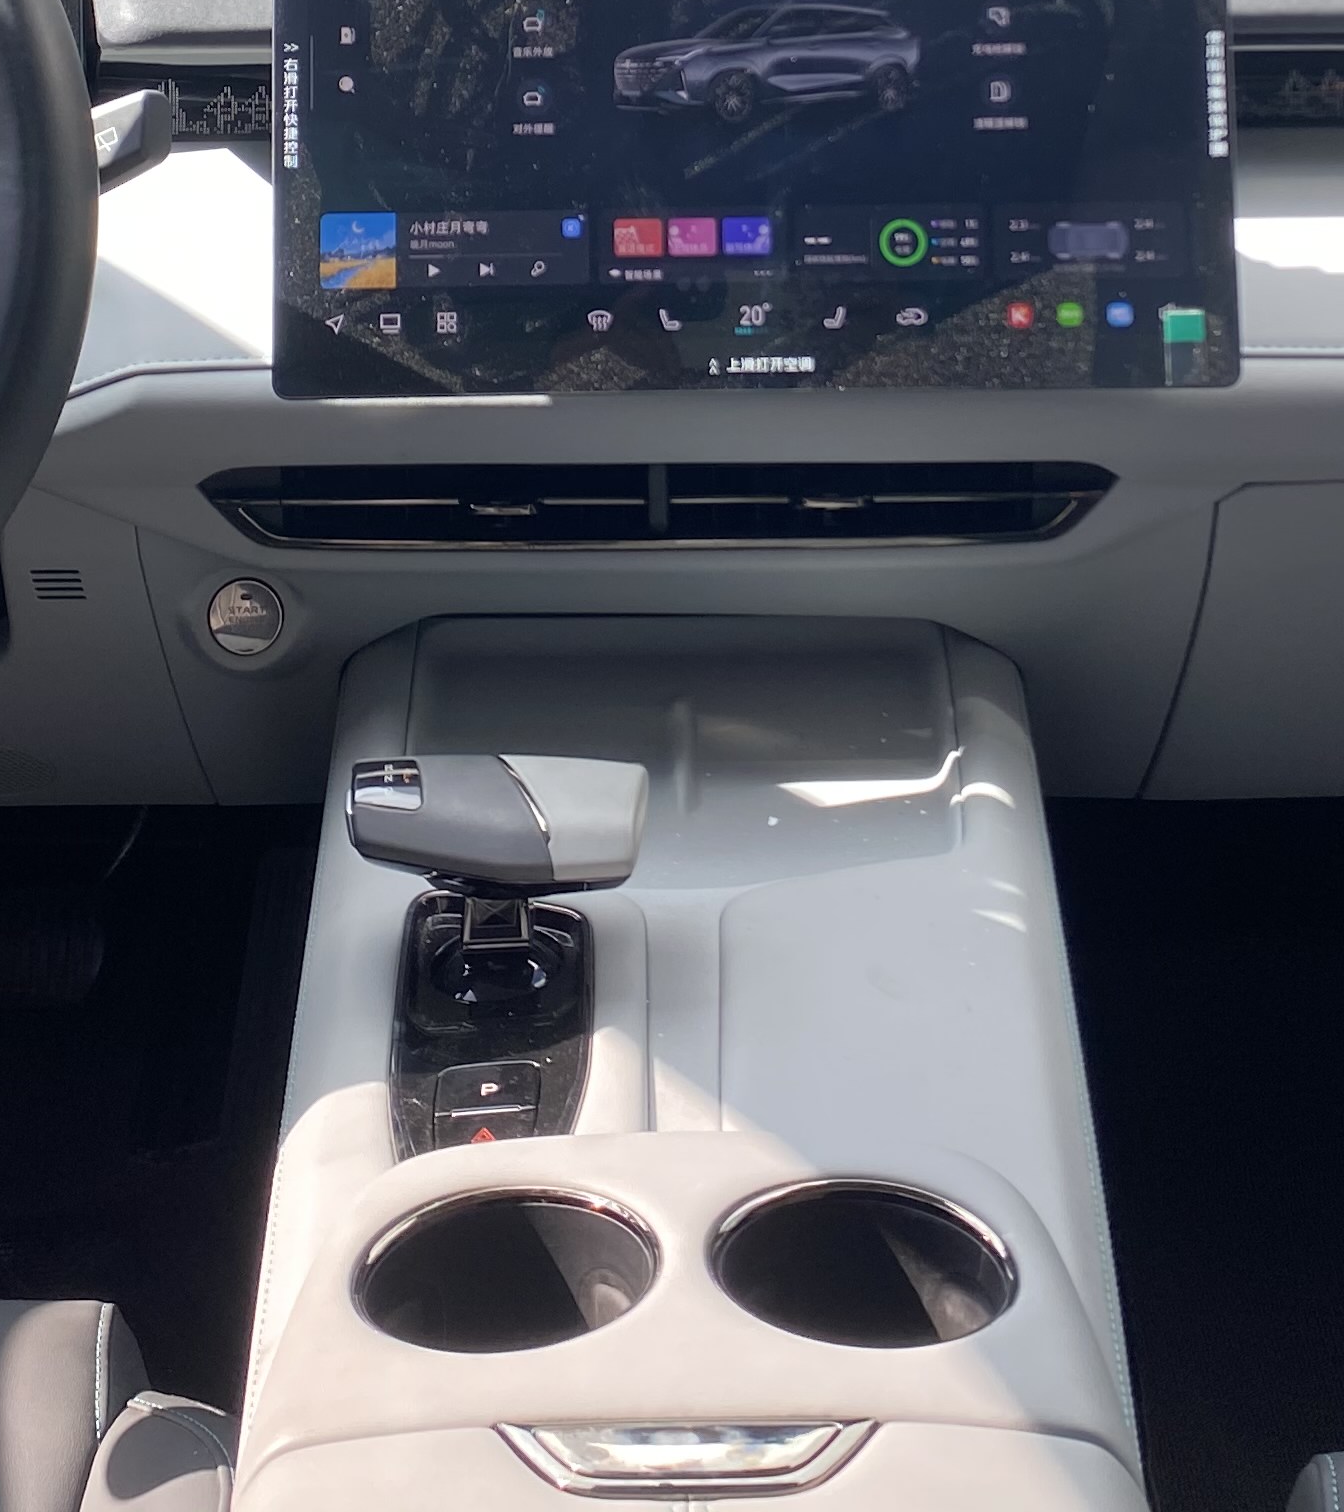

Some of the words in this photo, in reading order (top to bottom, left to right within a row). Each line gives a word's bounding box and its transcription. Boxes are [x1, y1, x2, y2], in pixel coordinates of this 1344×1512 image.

[283, 58, 299, 169] 右滑打开快捷控制
[726, 356, 815, 374] 上滑打开空调
[228, 605, 266, 615] START
[383, 774, 394, 784] N
[480, 1082, 499, 1097] P
